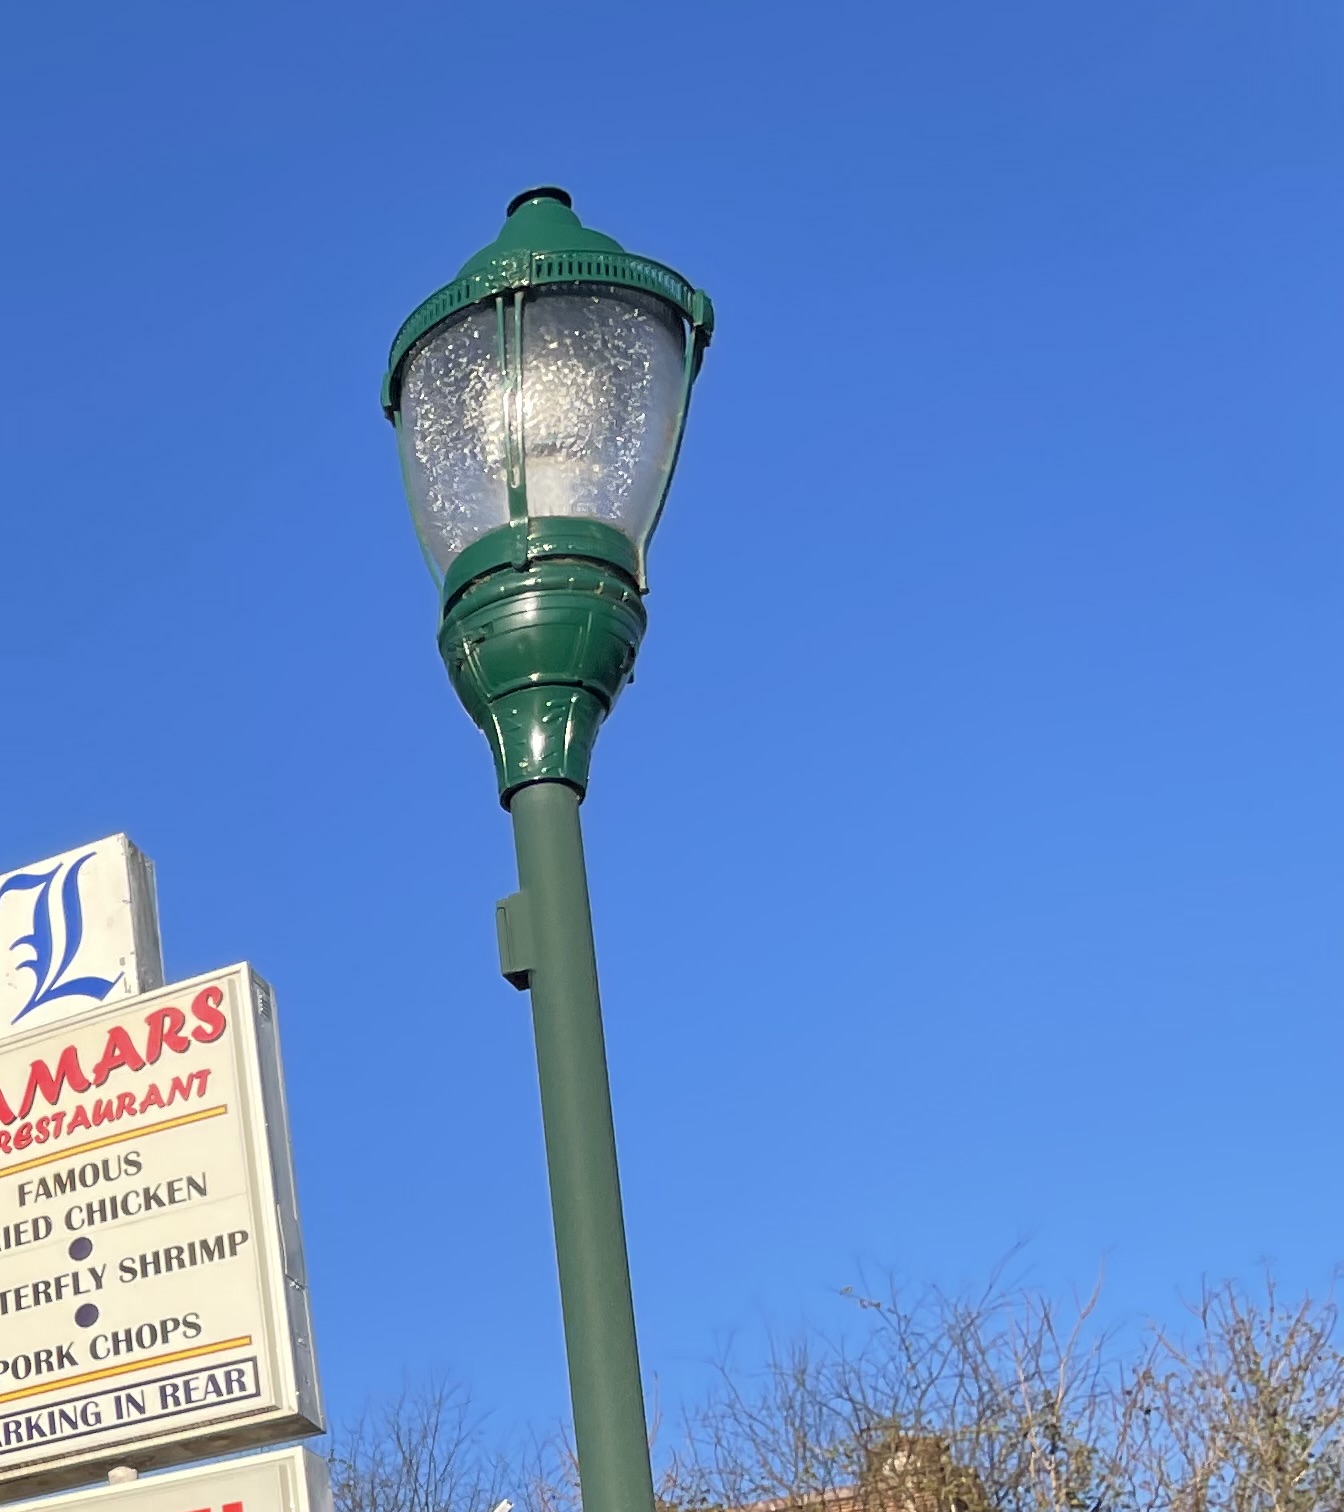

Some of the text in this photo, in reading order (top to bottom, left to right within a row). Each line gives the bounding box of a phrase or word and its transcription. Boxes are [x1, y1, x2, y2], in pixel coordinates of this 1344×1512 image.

[17, 1151, 143, 1208] FAMOUS
[64, 1172, 208, 1231] CHICKEN
[118, 1230, 250, 1284] SHRIMP
[89, 1312, 202, 1360] CHOPS
[115, 1392, 146, 1420] IN
[159, 1367, 247, 1410] REAR
